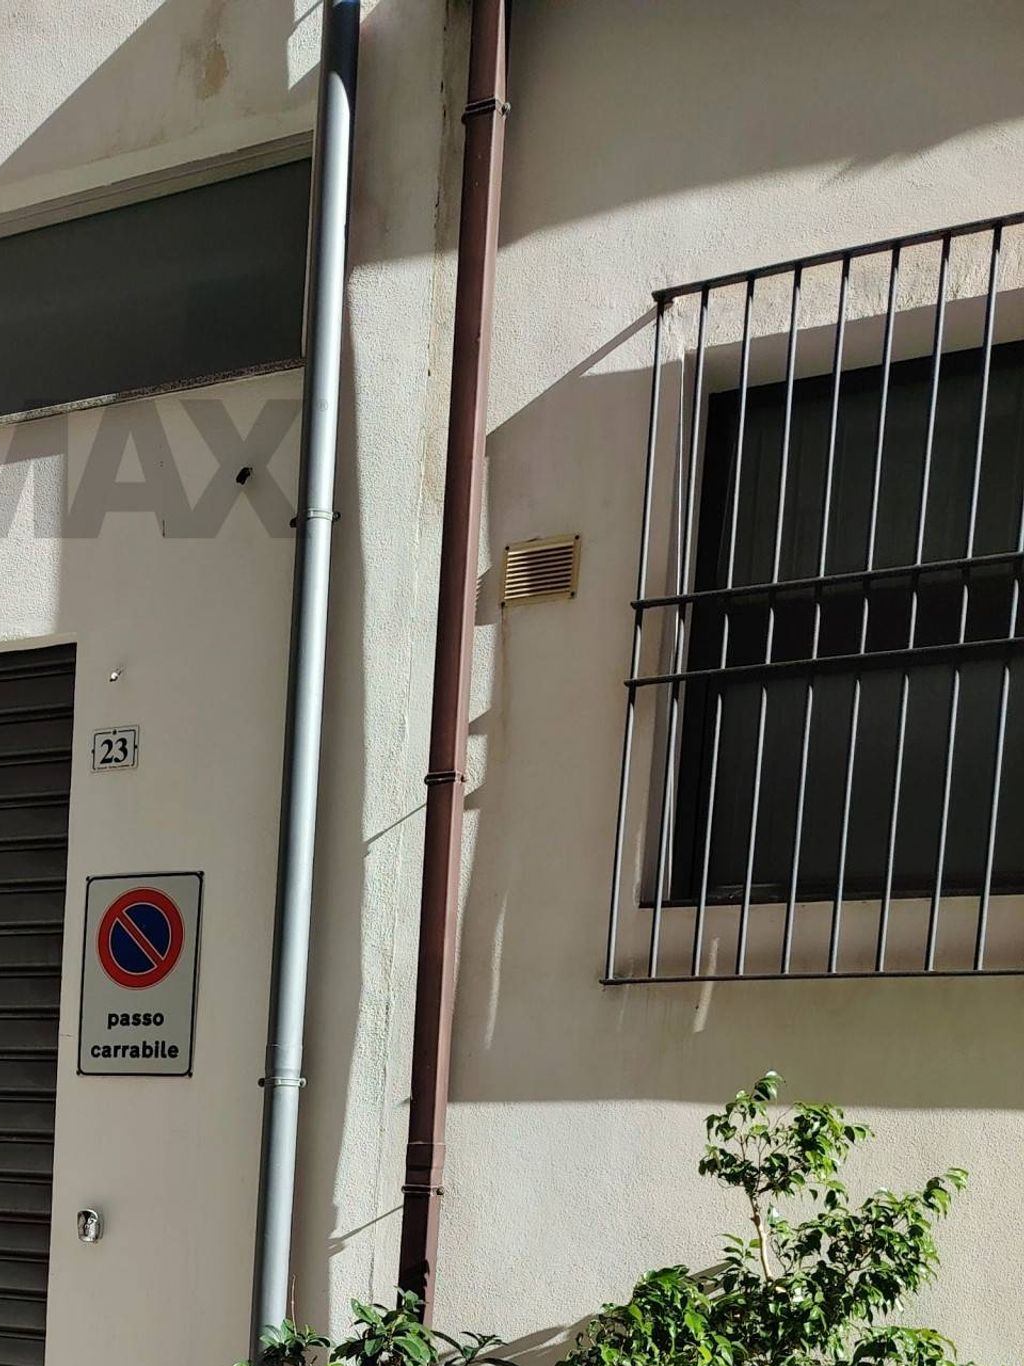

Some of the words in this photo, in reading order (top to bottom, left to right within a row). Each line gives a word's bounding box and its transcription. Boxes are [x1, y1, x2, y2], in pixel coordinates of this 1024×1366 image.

[99, 737, 128, 764] 23
[107, 1012, 165, 1030] passo
[90, 1040, 179, 1059] carrabile
